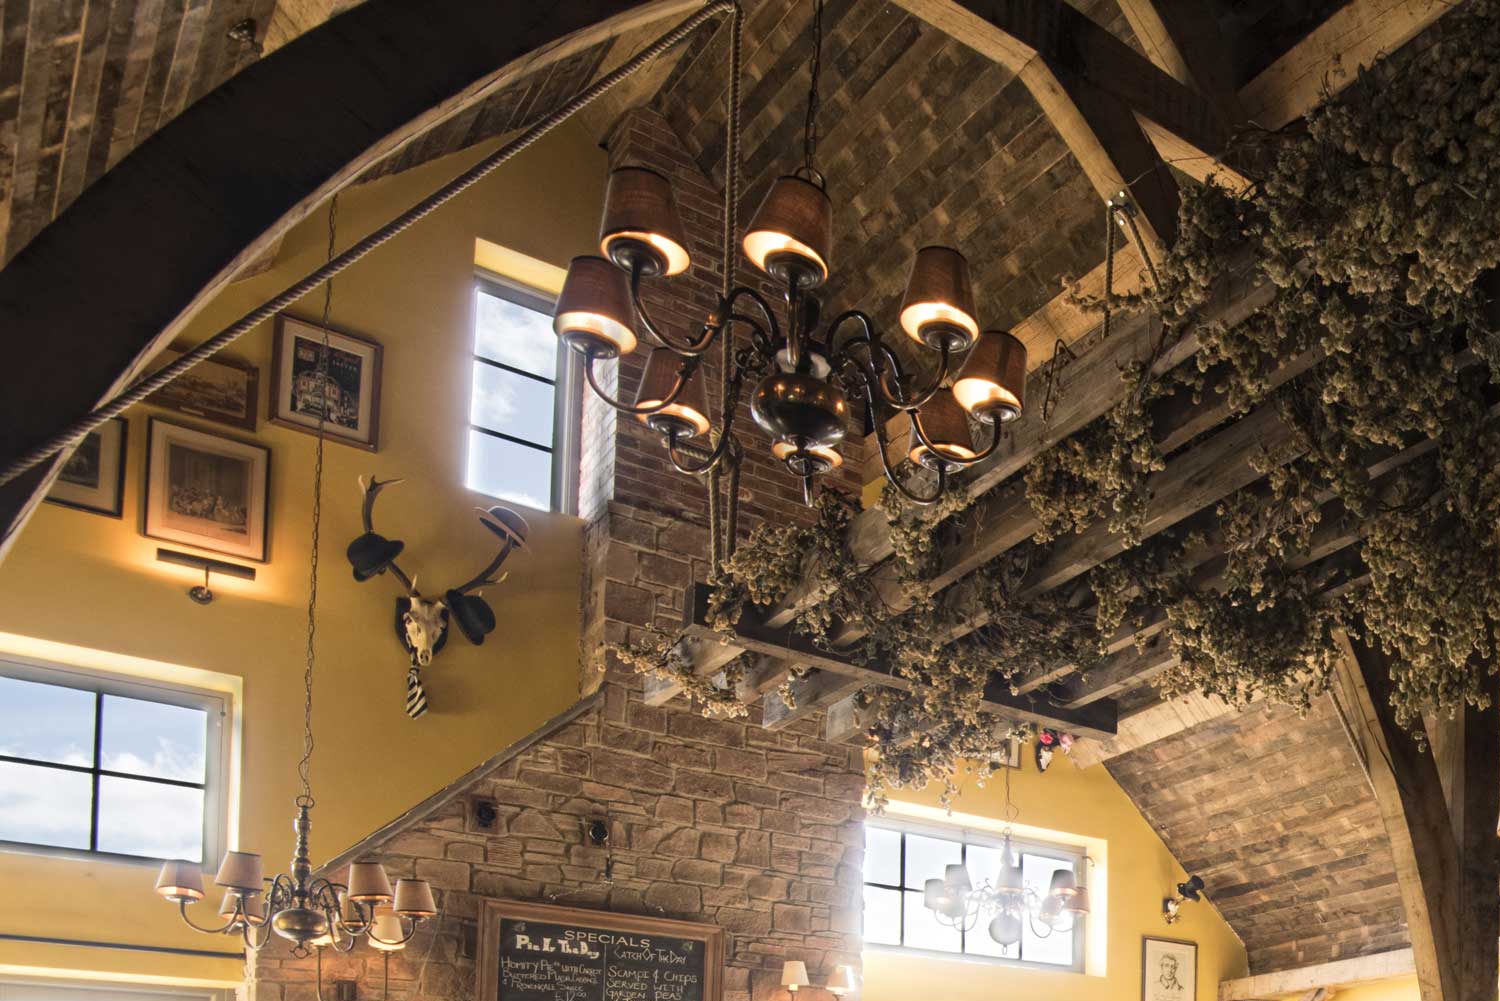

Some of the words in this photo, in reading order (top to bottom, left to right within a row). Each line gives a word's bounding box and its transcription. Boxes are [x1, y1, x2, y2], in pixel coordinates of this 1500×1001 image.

[564, 930, 650, 948] SPECIALS
[608, 965, 650, 981] SCAMPI
[664, 970, 698, 986] CHIPS
[606, 978, 648, 991] SERVED
[655, 991, 682, 1001] PEAS
